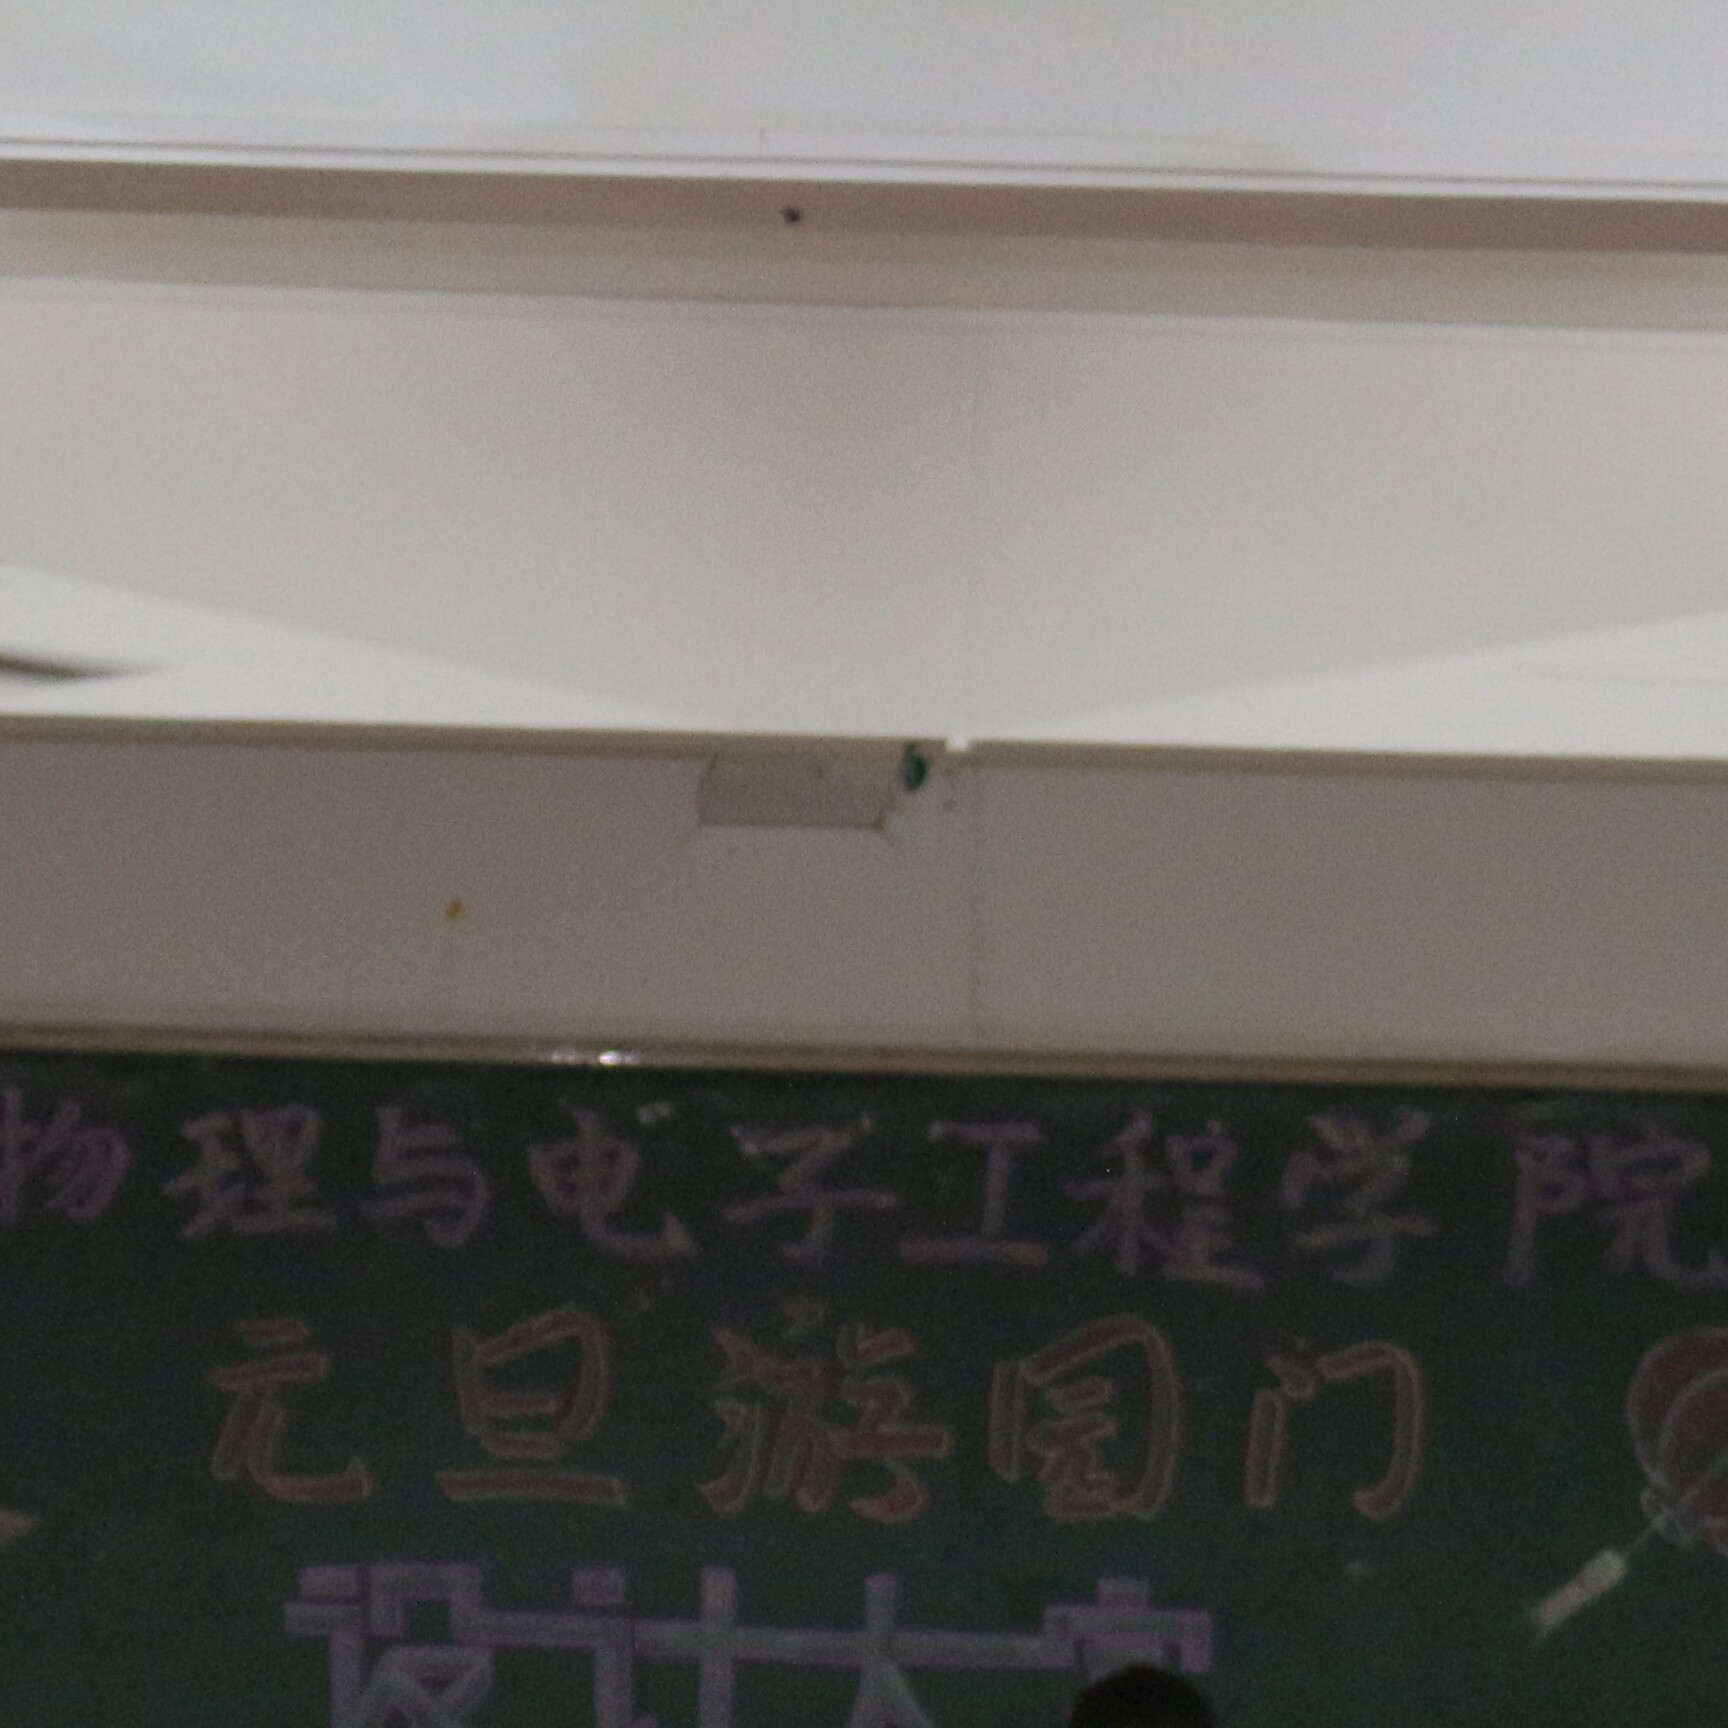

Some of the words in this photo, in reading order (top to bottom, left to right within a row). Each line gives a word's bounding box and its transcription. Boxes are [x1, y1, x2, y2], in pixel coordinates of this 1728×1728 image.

[204, 1297, 1426, 1522] 元旦游园门
